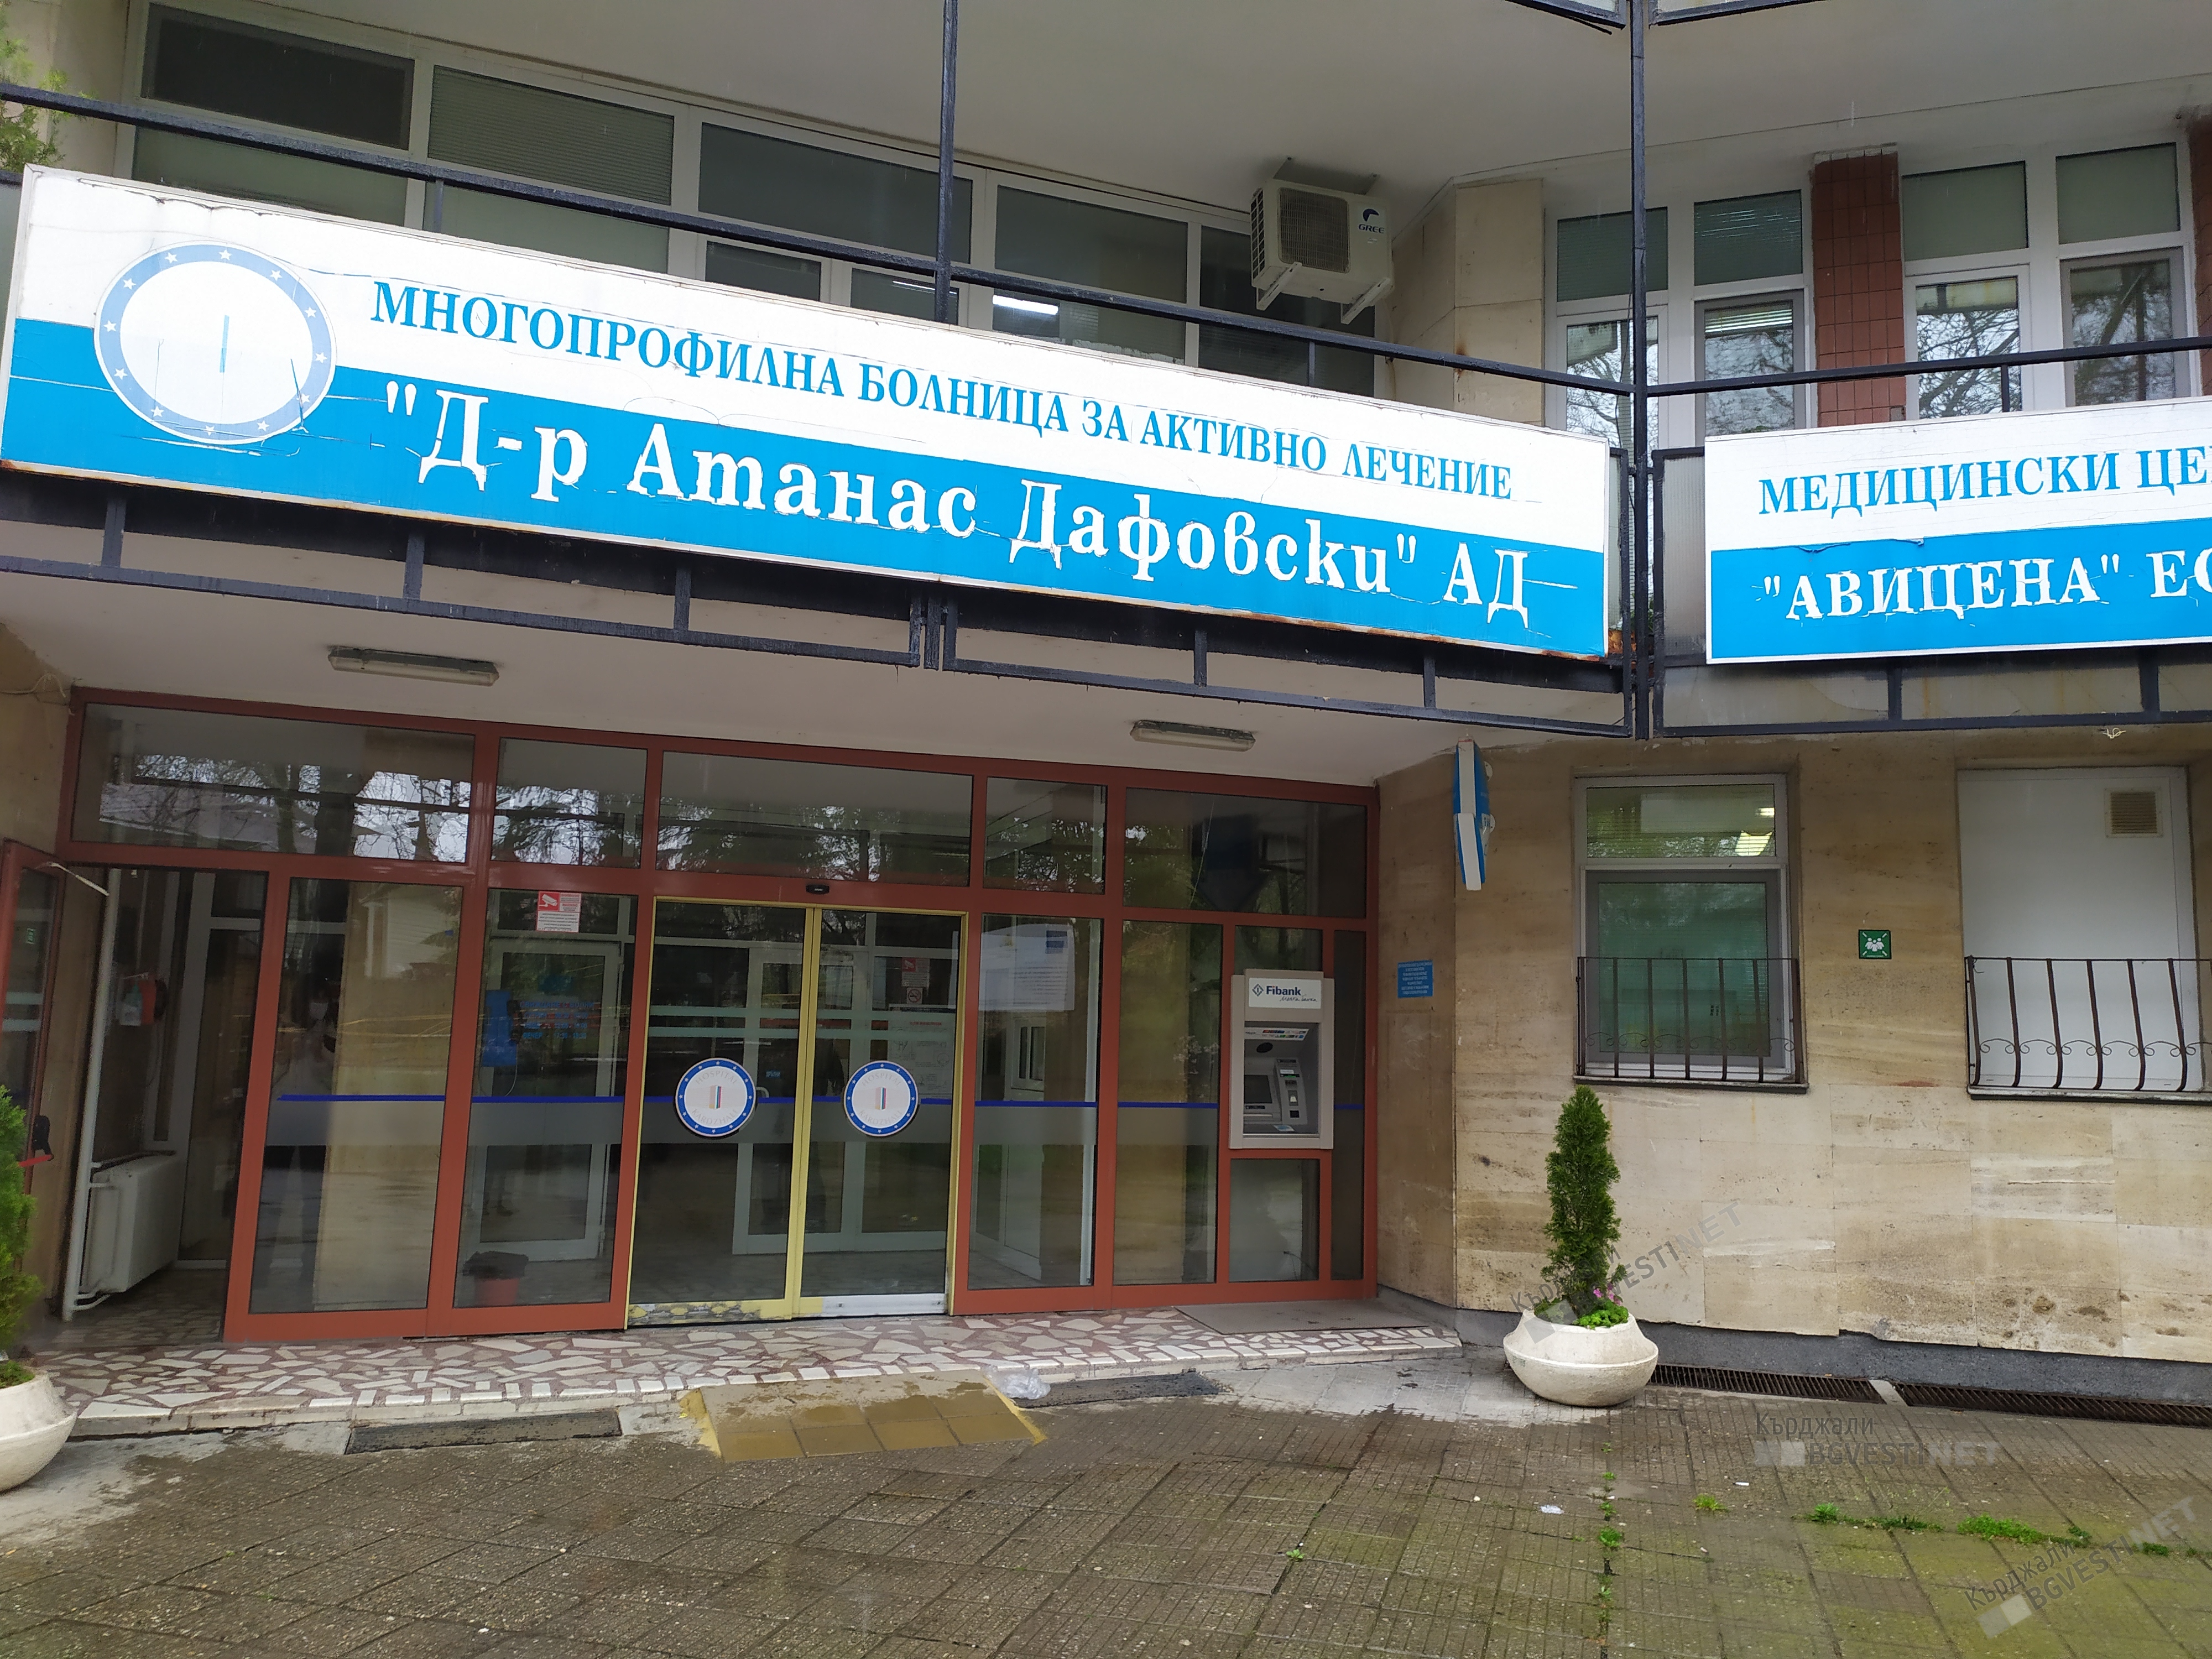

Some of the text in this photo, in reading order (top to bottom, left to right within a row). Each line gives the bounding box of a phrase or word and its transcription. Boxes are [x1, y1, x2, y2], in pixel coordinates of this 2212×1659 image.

[1359, 224, 1385, 234] GREE
[371, 281, 1511, 499] МНОГОПРОФИЛНА БОЛНИЦА ЗА АКТИВНО ЛЕЧЕНИЕ
[386, 380, 1529, 629] "Д-р Атанас Дафовски" АД
[1759, 446, 2212, 519] МЕДИЦИНСКИ ЦЕ
[1763, 553, 2120, 620] "АВИЦЕНА"
[1266, 985, 1301, 996] Fibank
